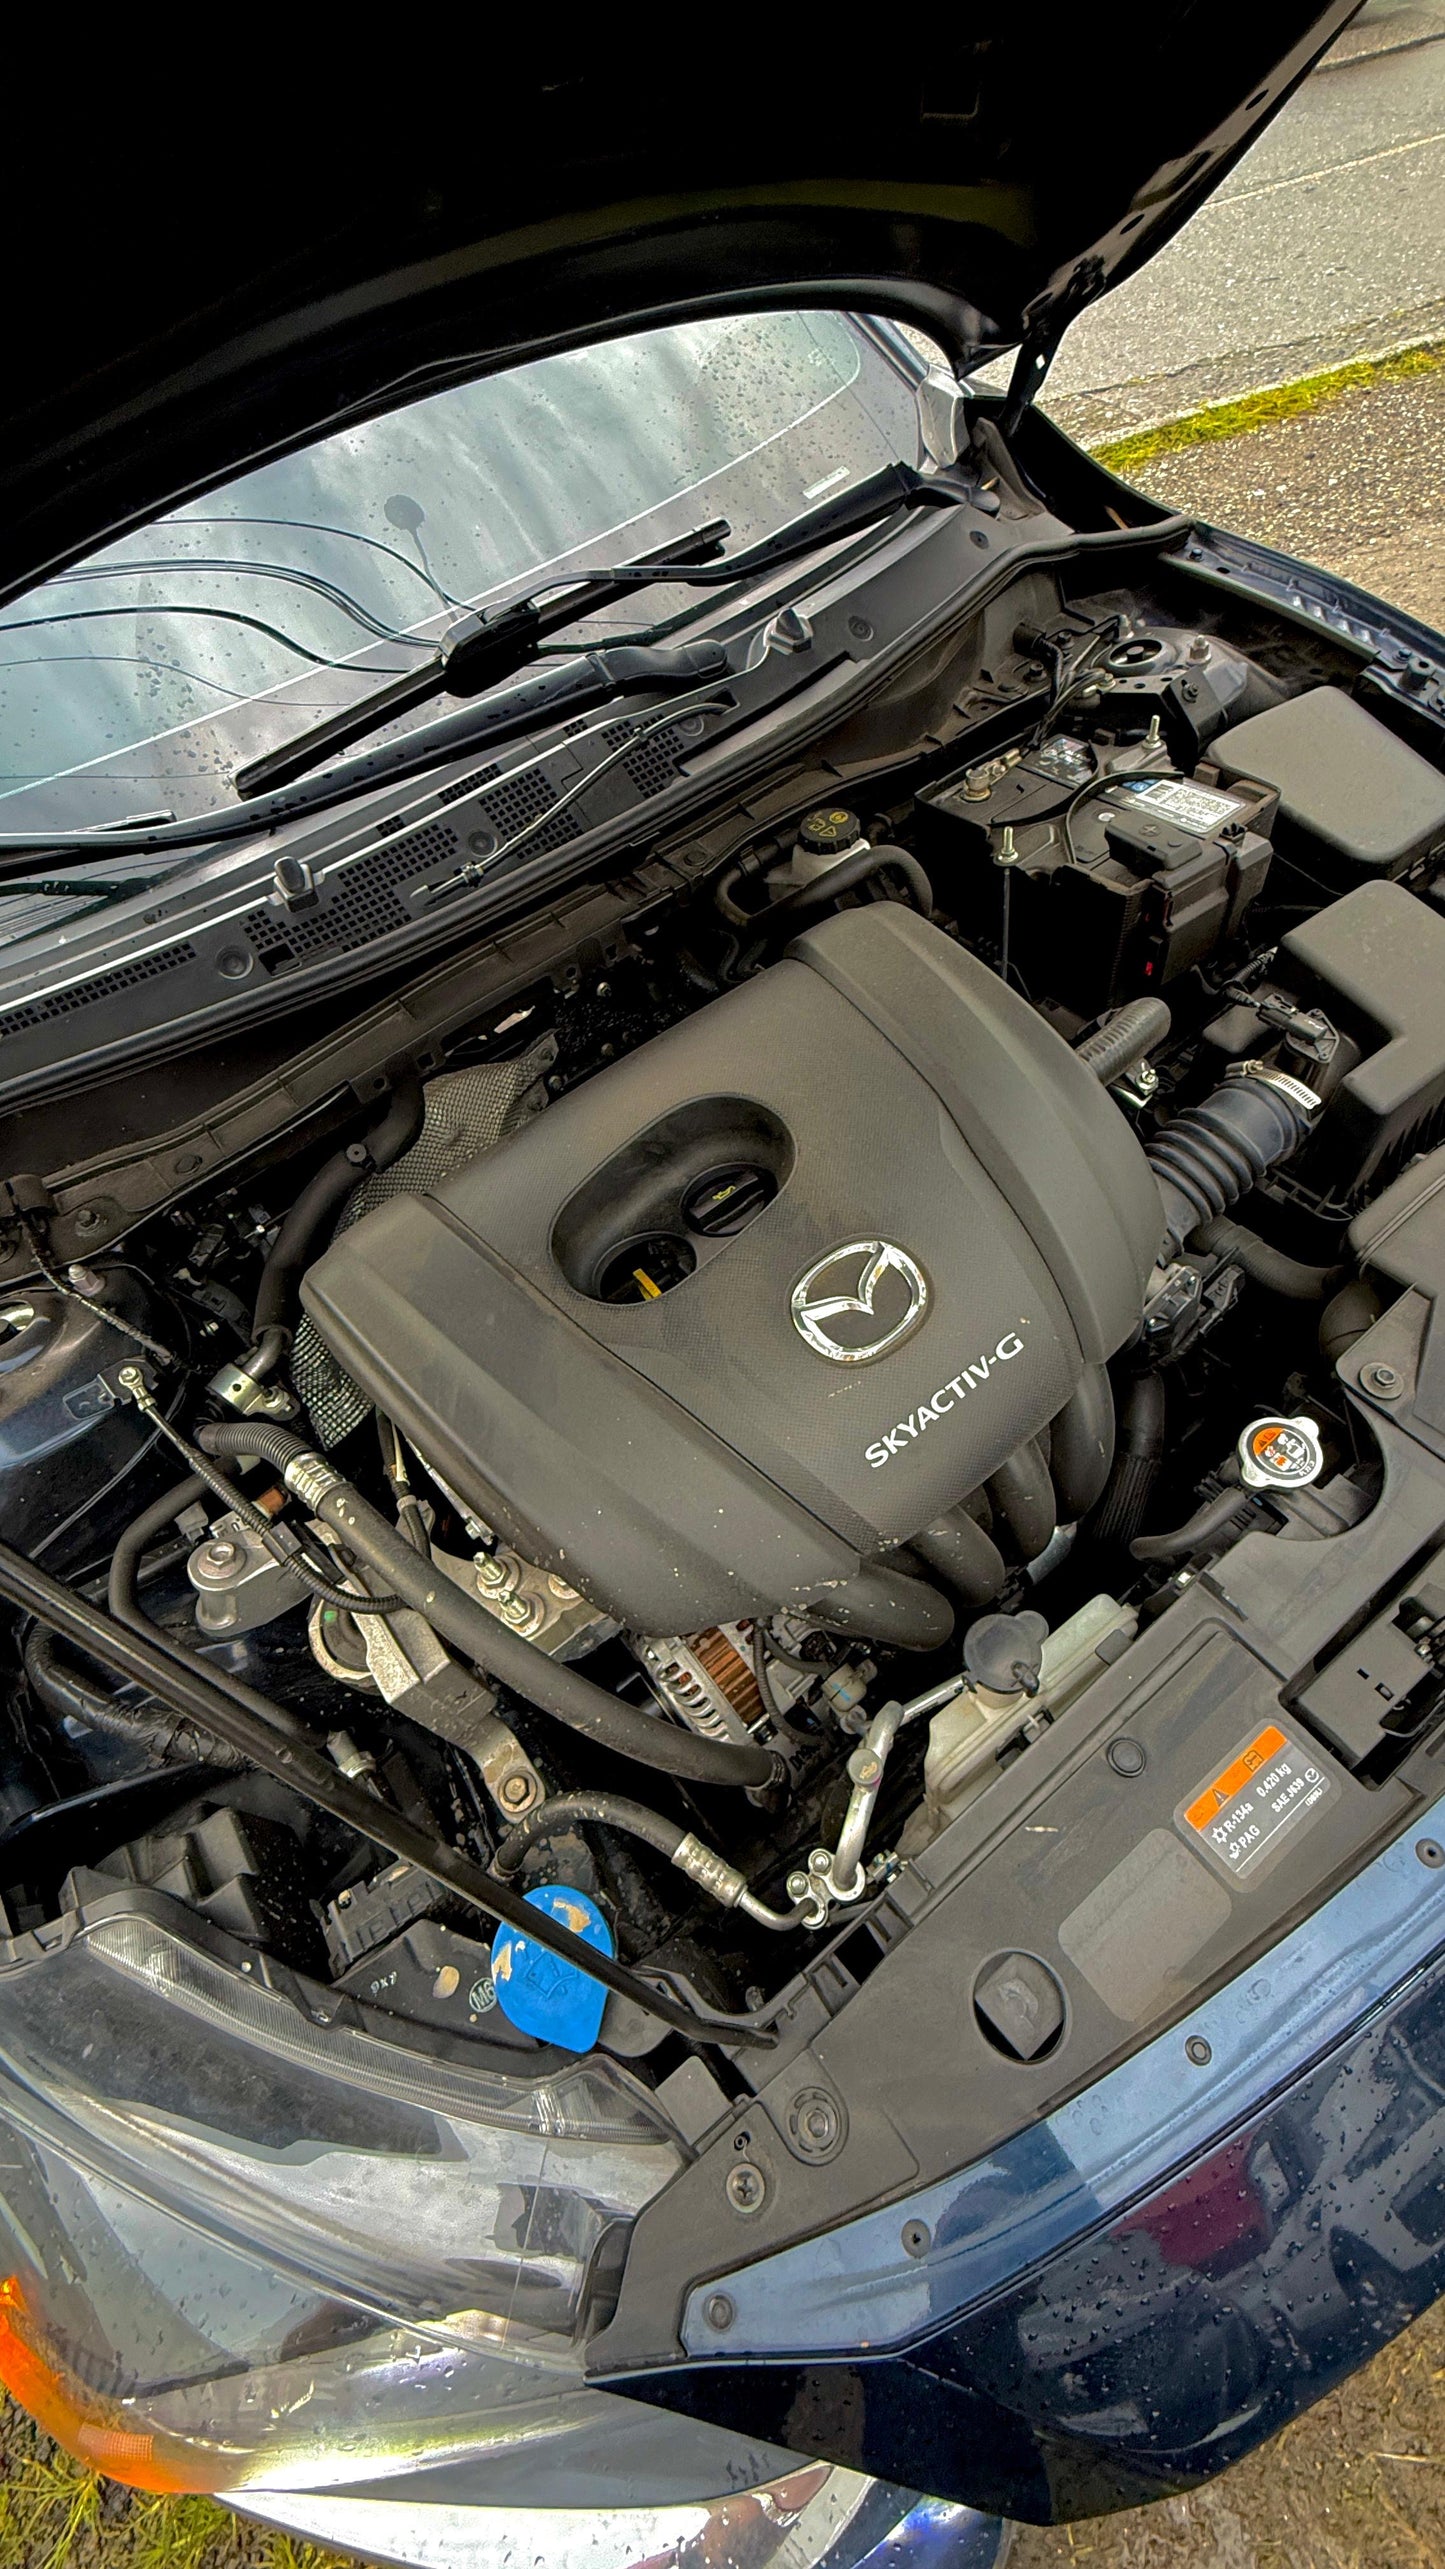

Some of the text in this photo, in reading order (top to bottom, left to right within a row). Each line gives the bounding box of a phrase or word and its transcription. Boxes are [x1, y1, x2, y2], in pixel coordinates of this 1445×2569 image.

[864, 1332, 1025, 1468] SKYACTIV-G
[1223, 1762, 1292, 1833] R-134a 0.420 kg
[1237, 1777, 1305, 1849] PAG SAE J639
